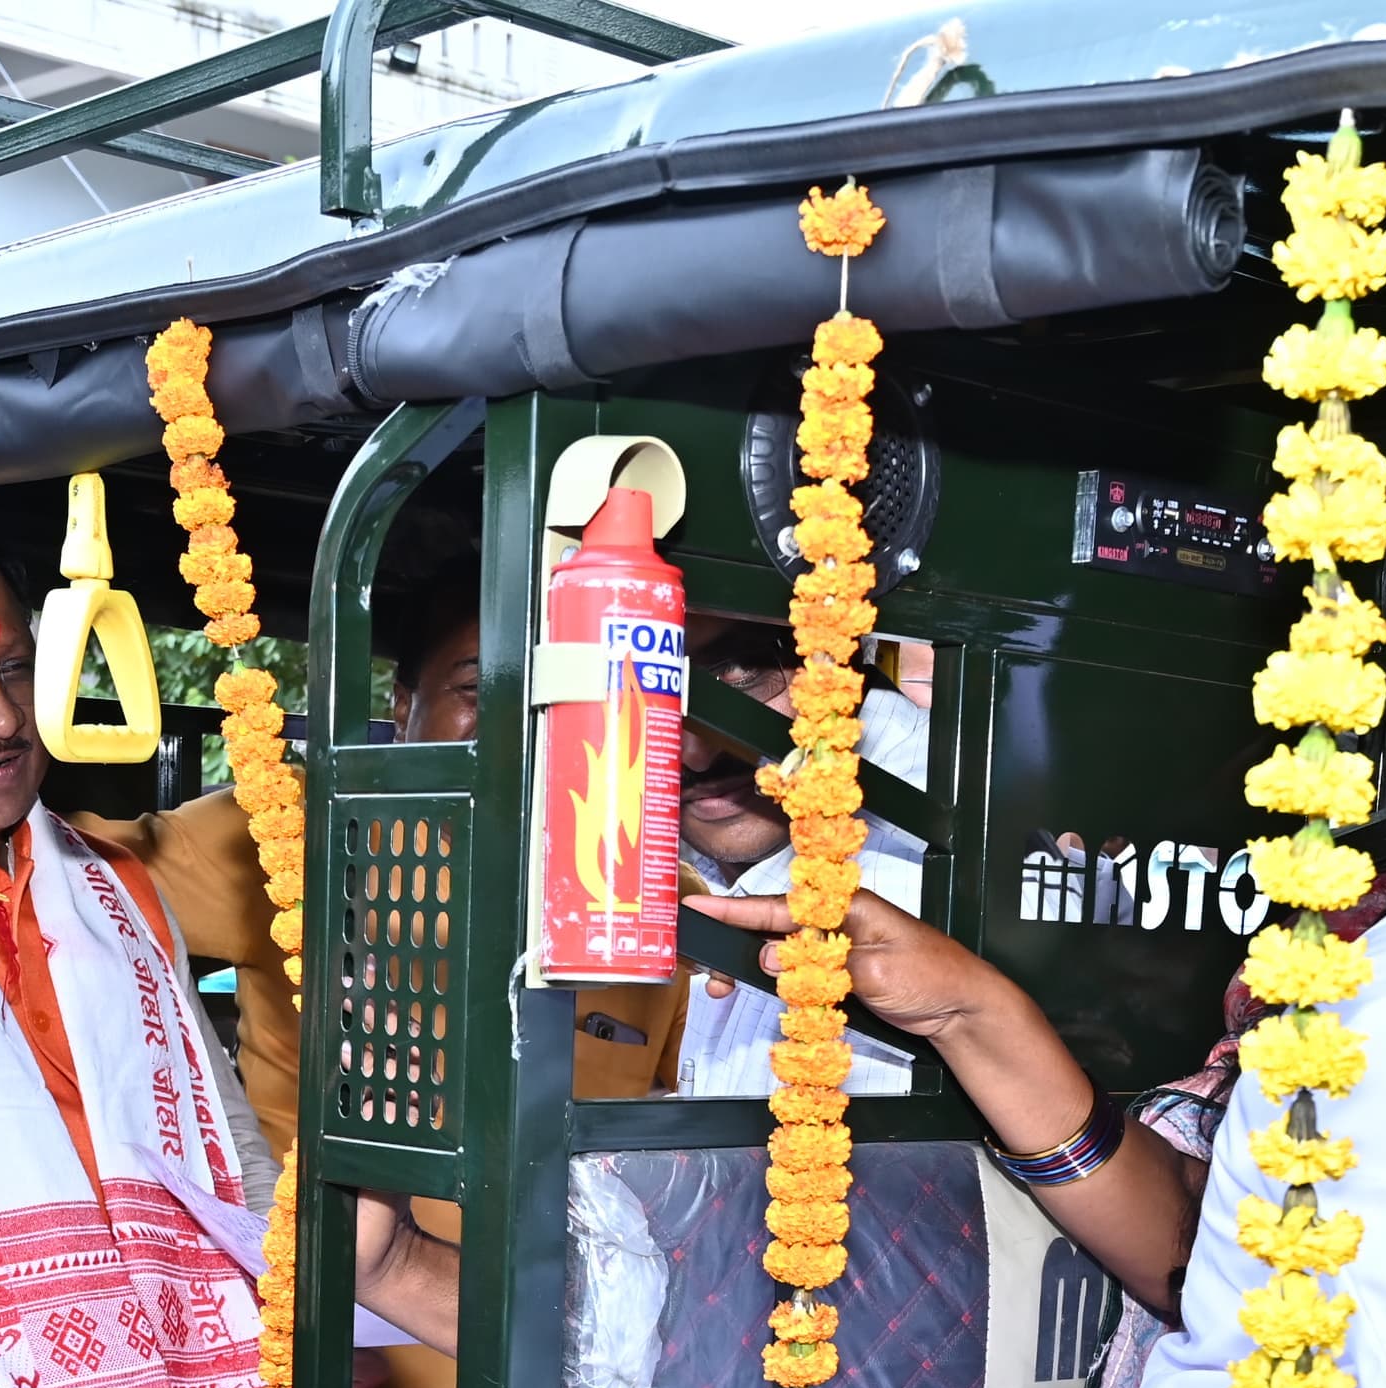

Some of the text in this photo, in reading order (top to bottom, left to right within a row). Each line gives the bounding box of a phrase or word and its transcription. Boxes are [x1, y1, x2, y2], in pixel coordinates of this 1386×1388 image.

[80, 861, 186, 1161] जोहार जोहार जोहार
